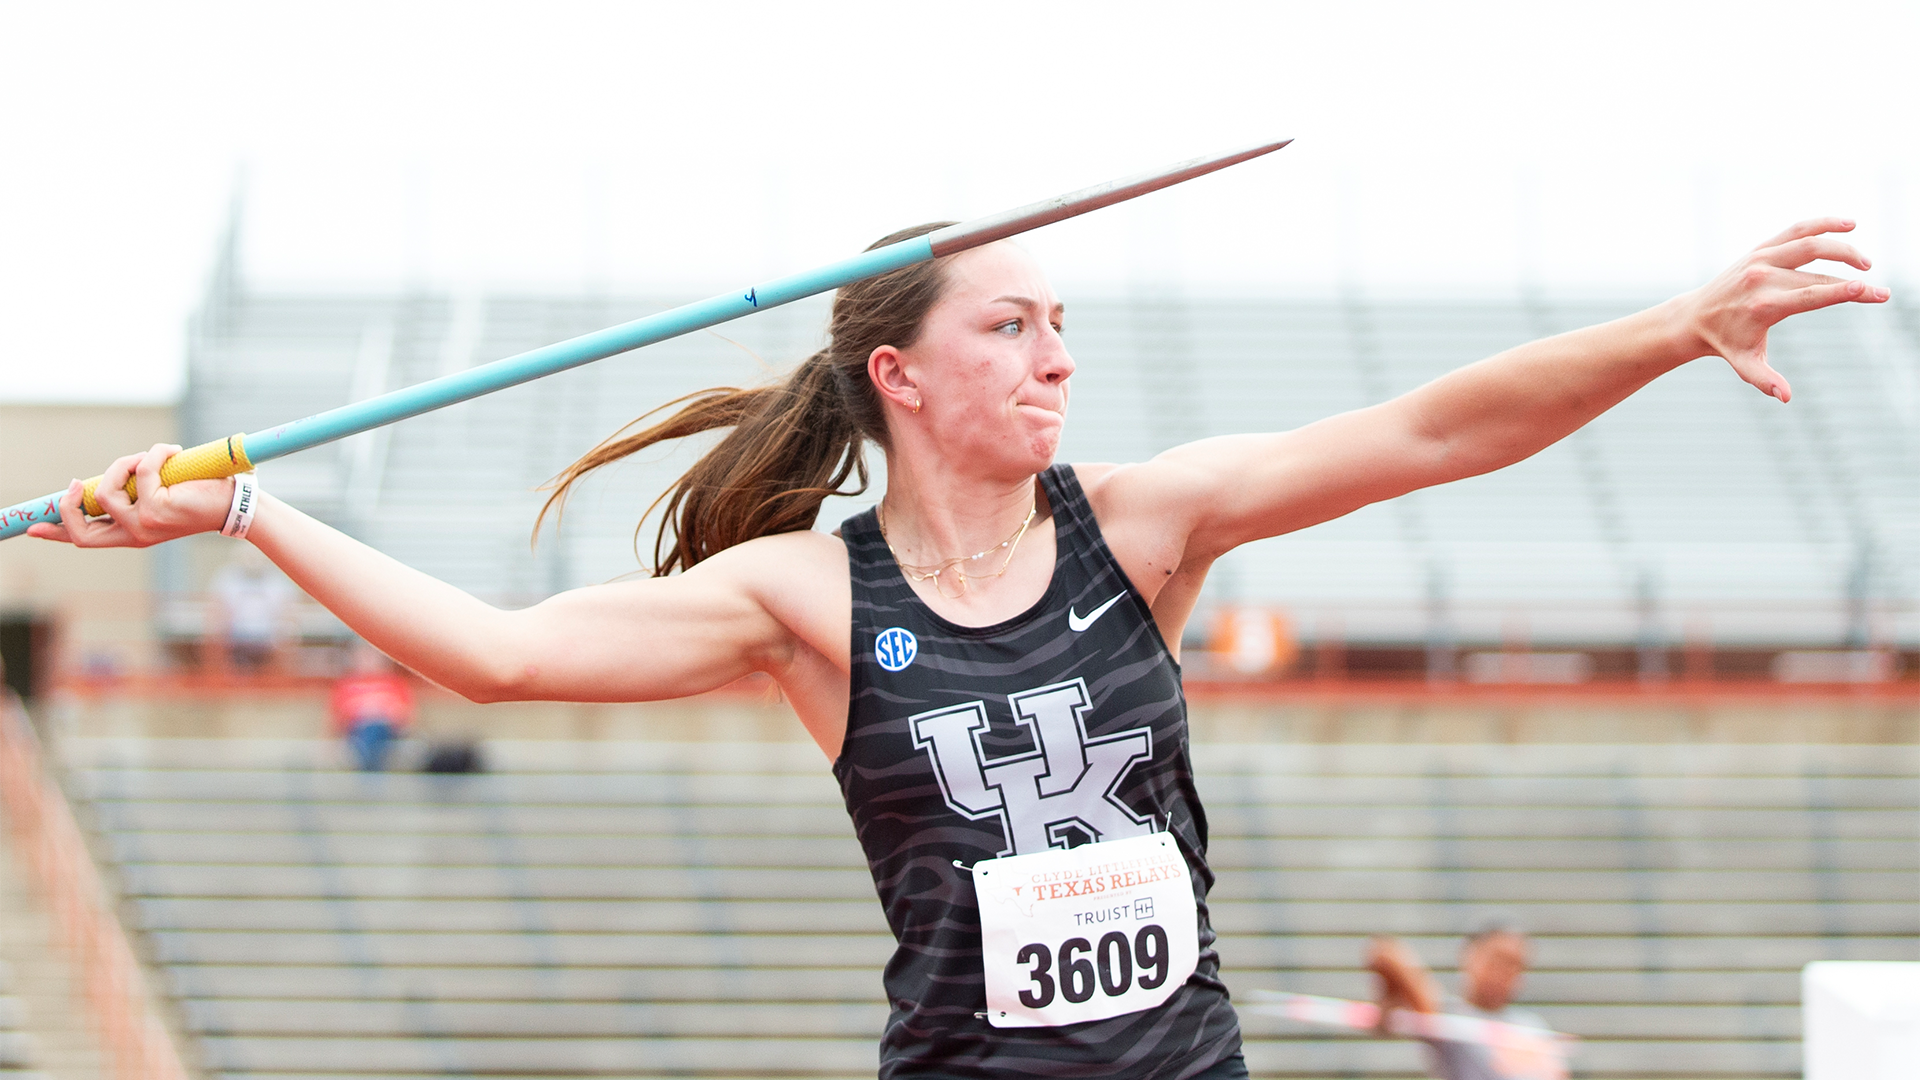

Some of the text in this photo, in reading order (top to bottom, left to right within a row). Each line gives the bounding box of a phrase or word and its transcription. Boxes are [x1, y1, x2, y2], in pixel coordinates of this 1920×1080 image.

[876, 630, 915, 668] SEC
[908, 676, 1158, 859] UK
[1031, 853, 1175, 884] CLYDE LITTLEFIELD
[1033, 864, 1181, 901] TEXAS RELAYS
[1074, 905, 1130, 926] TRUIST
[1016, 924, 1169, 1009] 3609
